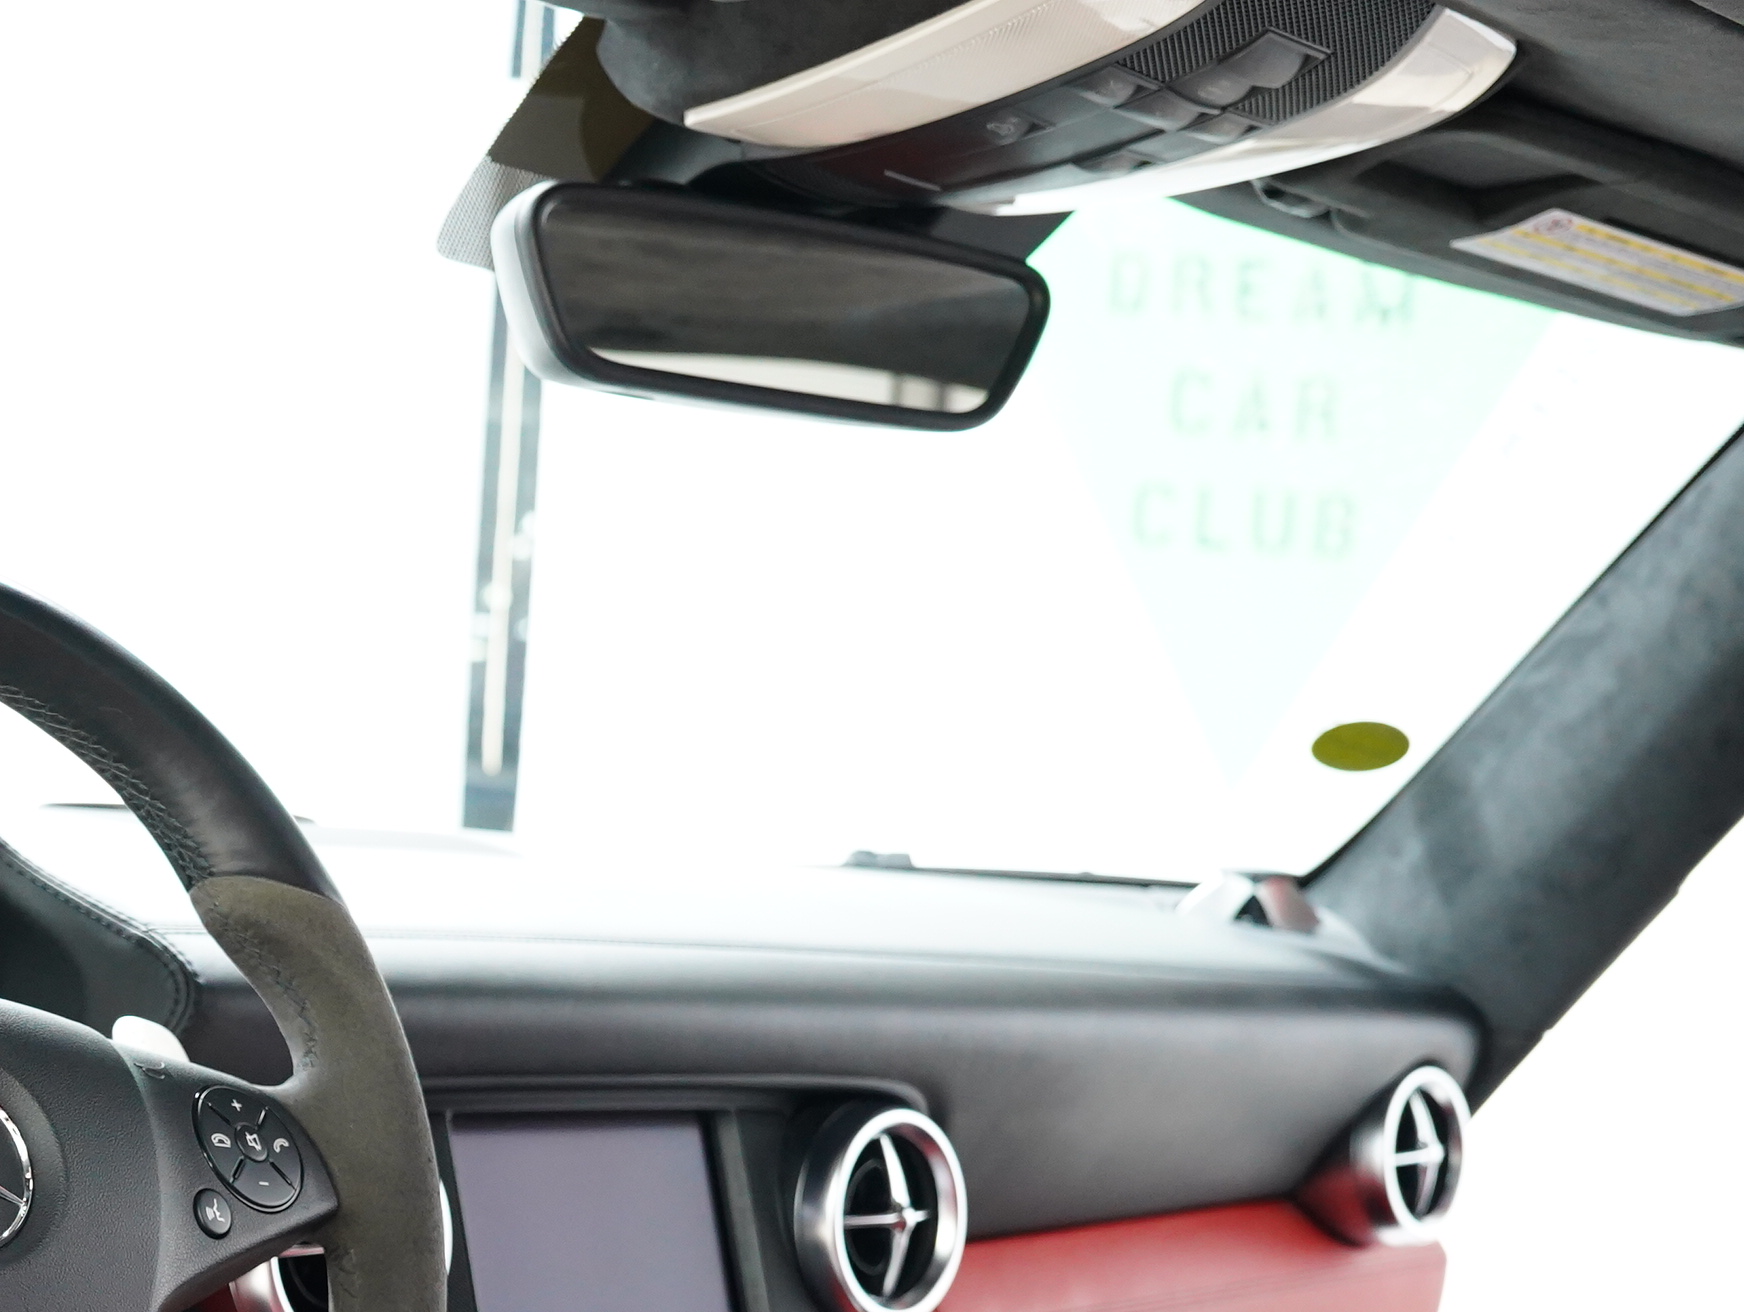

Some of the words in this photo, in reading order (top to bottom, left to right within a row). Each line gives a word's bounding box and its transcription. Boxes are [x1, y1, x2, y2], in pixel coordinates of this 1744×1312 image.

[1107, 249, 1418, 327] DREAM
[1167, 366, 1342, 442] CAR
[1129, 480, 1360, 561] CLUB
